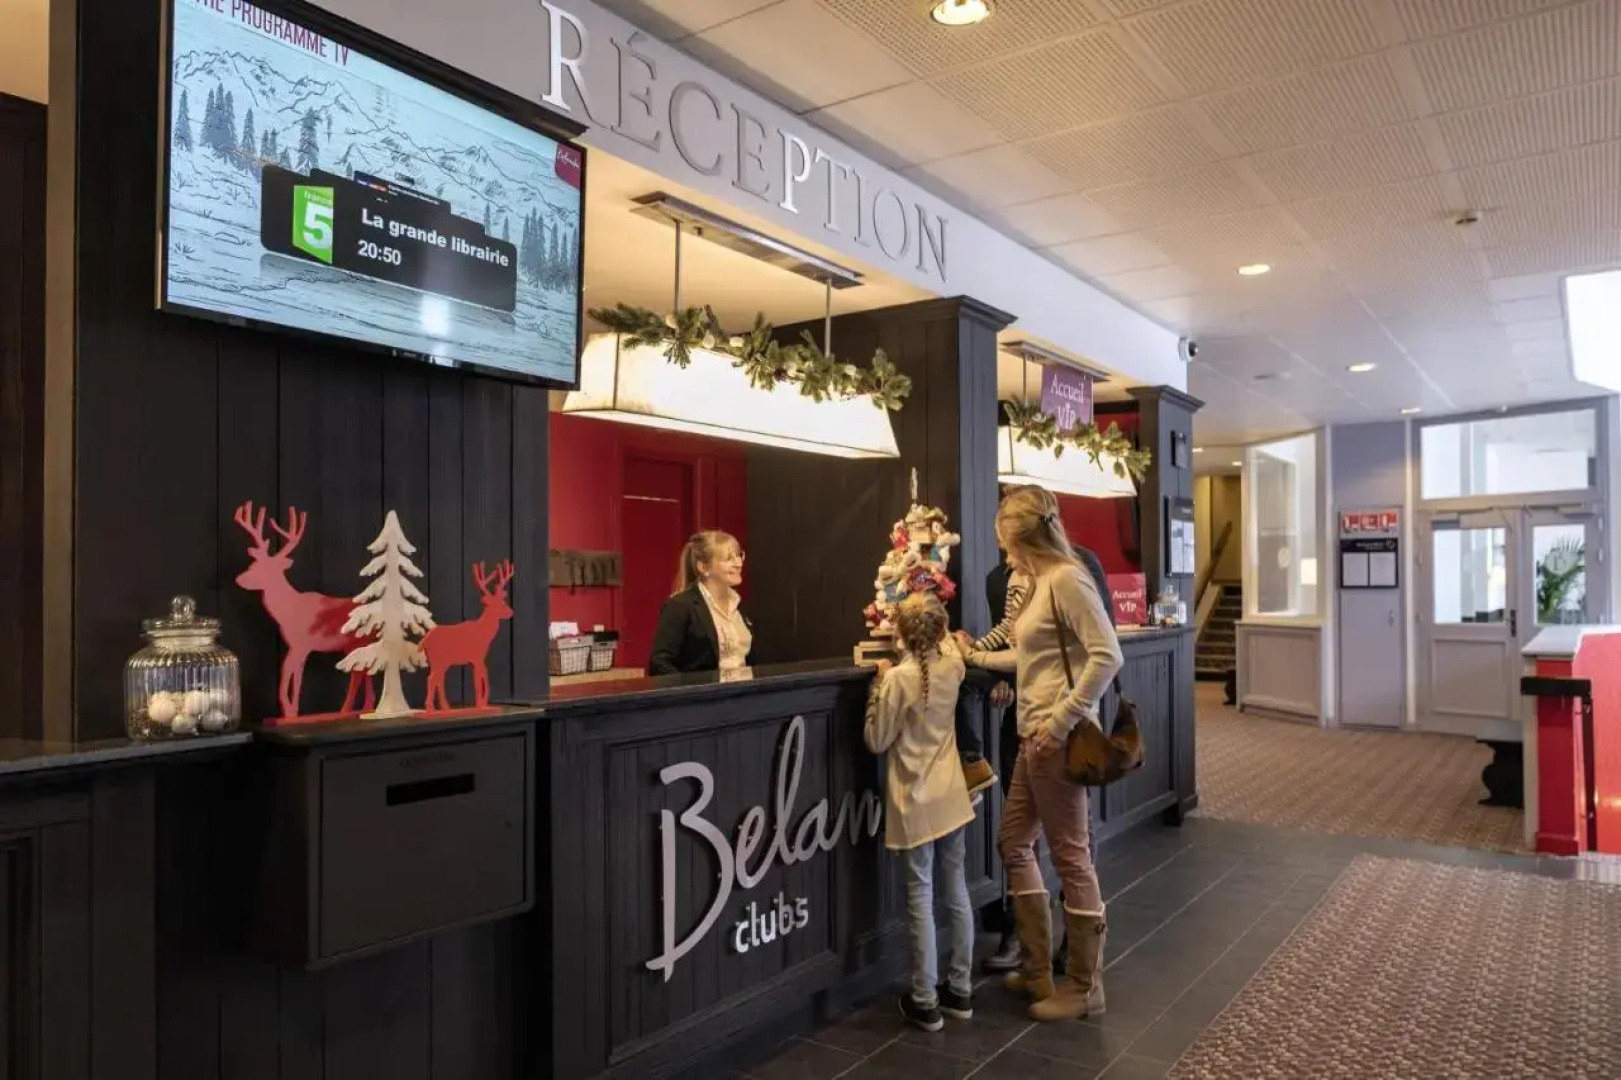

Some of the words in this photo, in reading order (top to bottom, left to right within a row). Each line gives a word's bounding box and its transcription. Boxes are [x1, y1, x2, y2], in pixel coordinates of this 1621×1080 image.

[231, 0, 328, 58] PROGRAMME
[335, 43, 350, 67] TV
[303, 201, 334, 249] 5
[357, 238, 402, 266] 20:50
[361, 207, 384, 230] La
[388, 220, 447, 248] grande
[451, 235, 509, 267] librairie
[1050, 374, 1085, 404] Accueil
[645, 715, 882, 983] Belam
[735, 891, 809, 953] clubs
